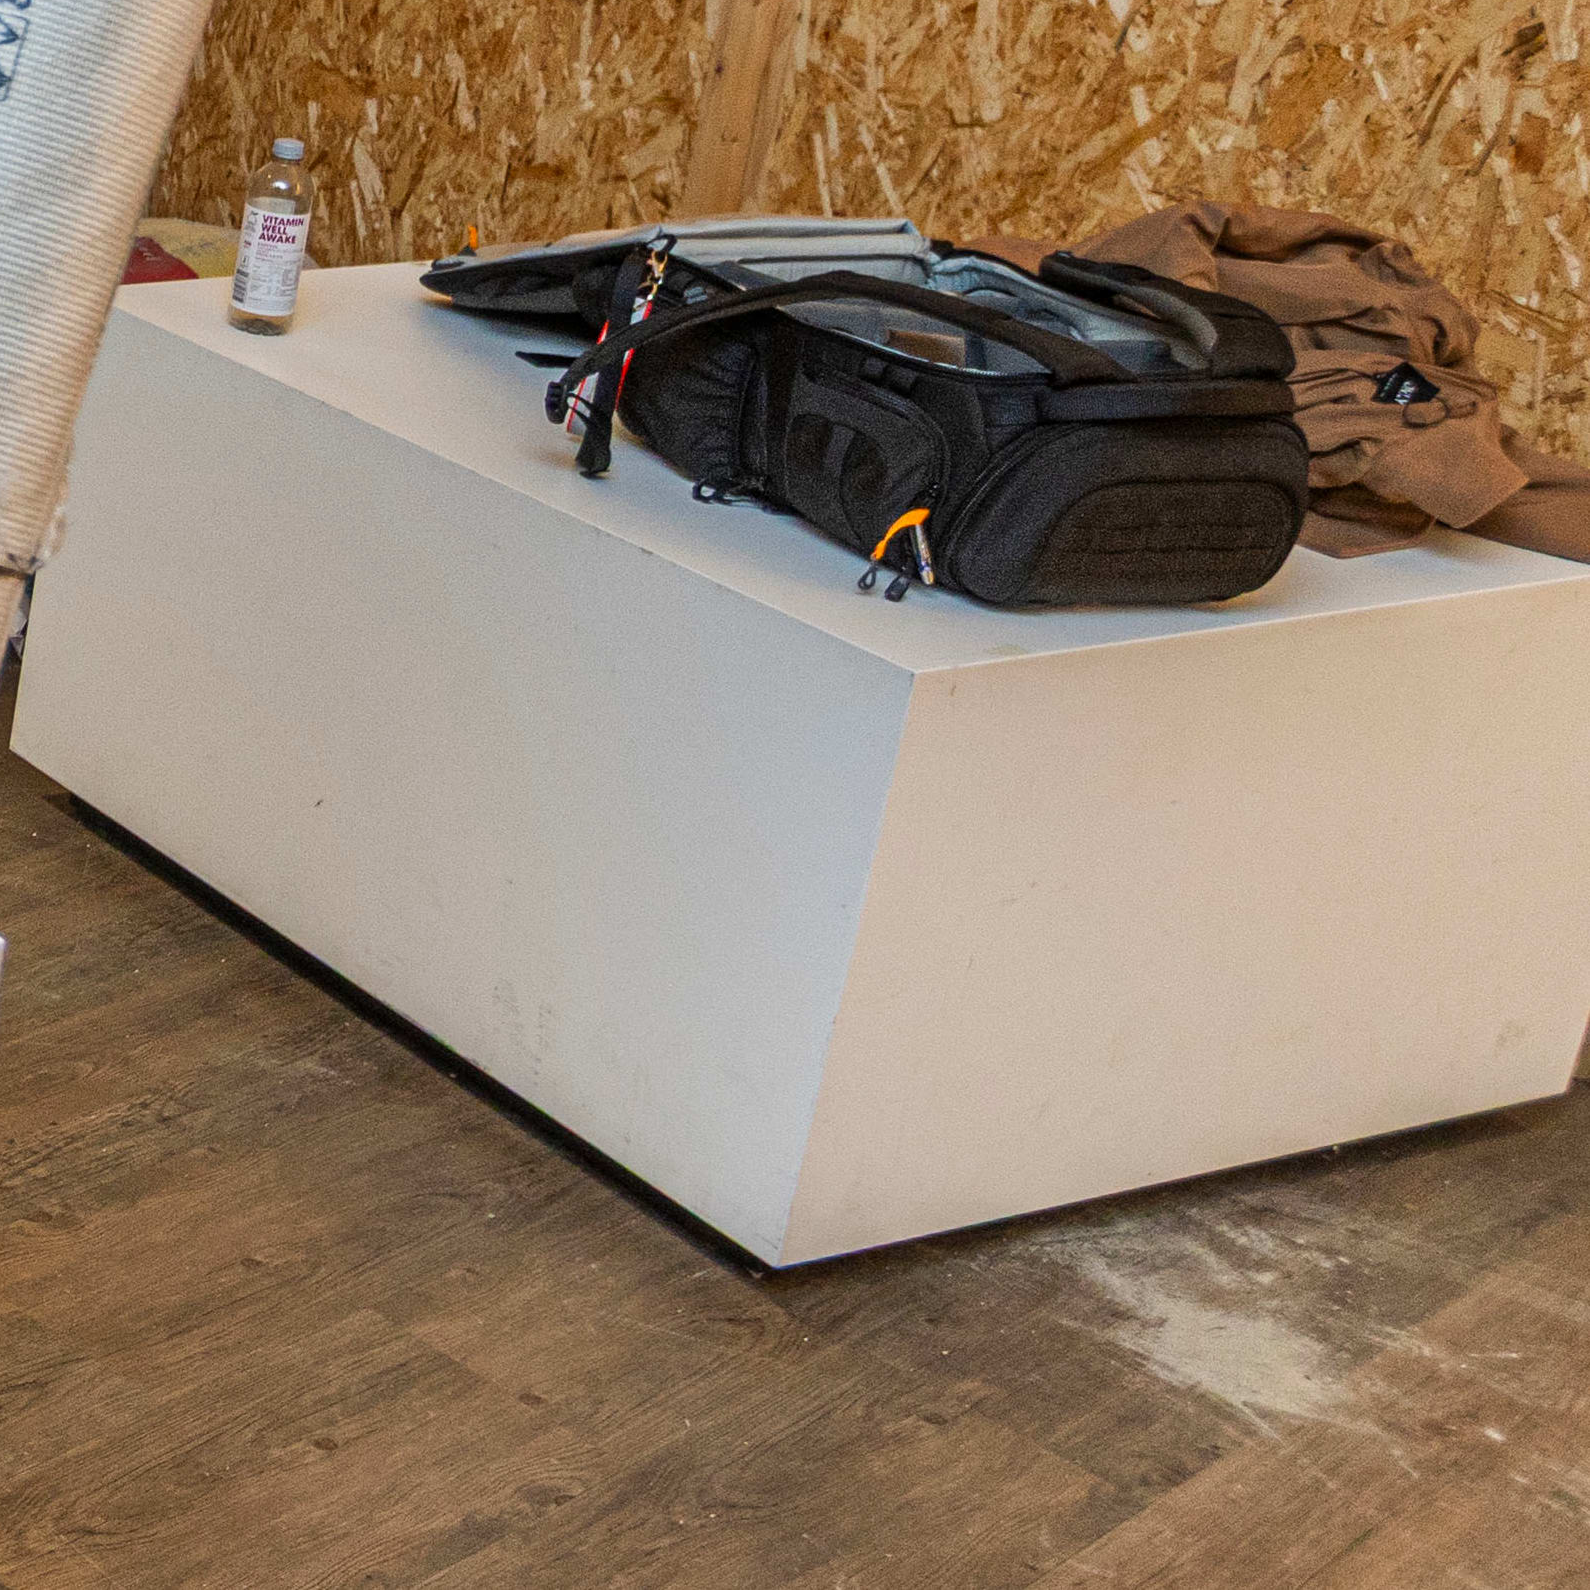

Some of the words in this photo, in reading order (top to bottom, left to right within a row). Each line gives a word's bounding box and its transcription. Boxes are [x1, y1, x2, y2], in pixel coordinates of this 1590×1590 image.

[262, 214, 305, 227] VITAMIN
[261, 223, 288, 236] WELL
[258, 233, 297, 245] AWAKE
